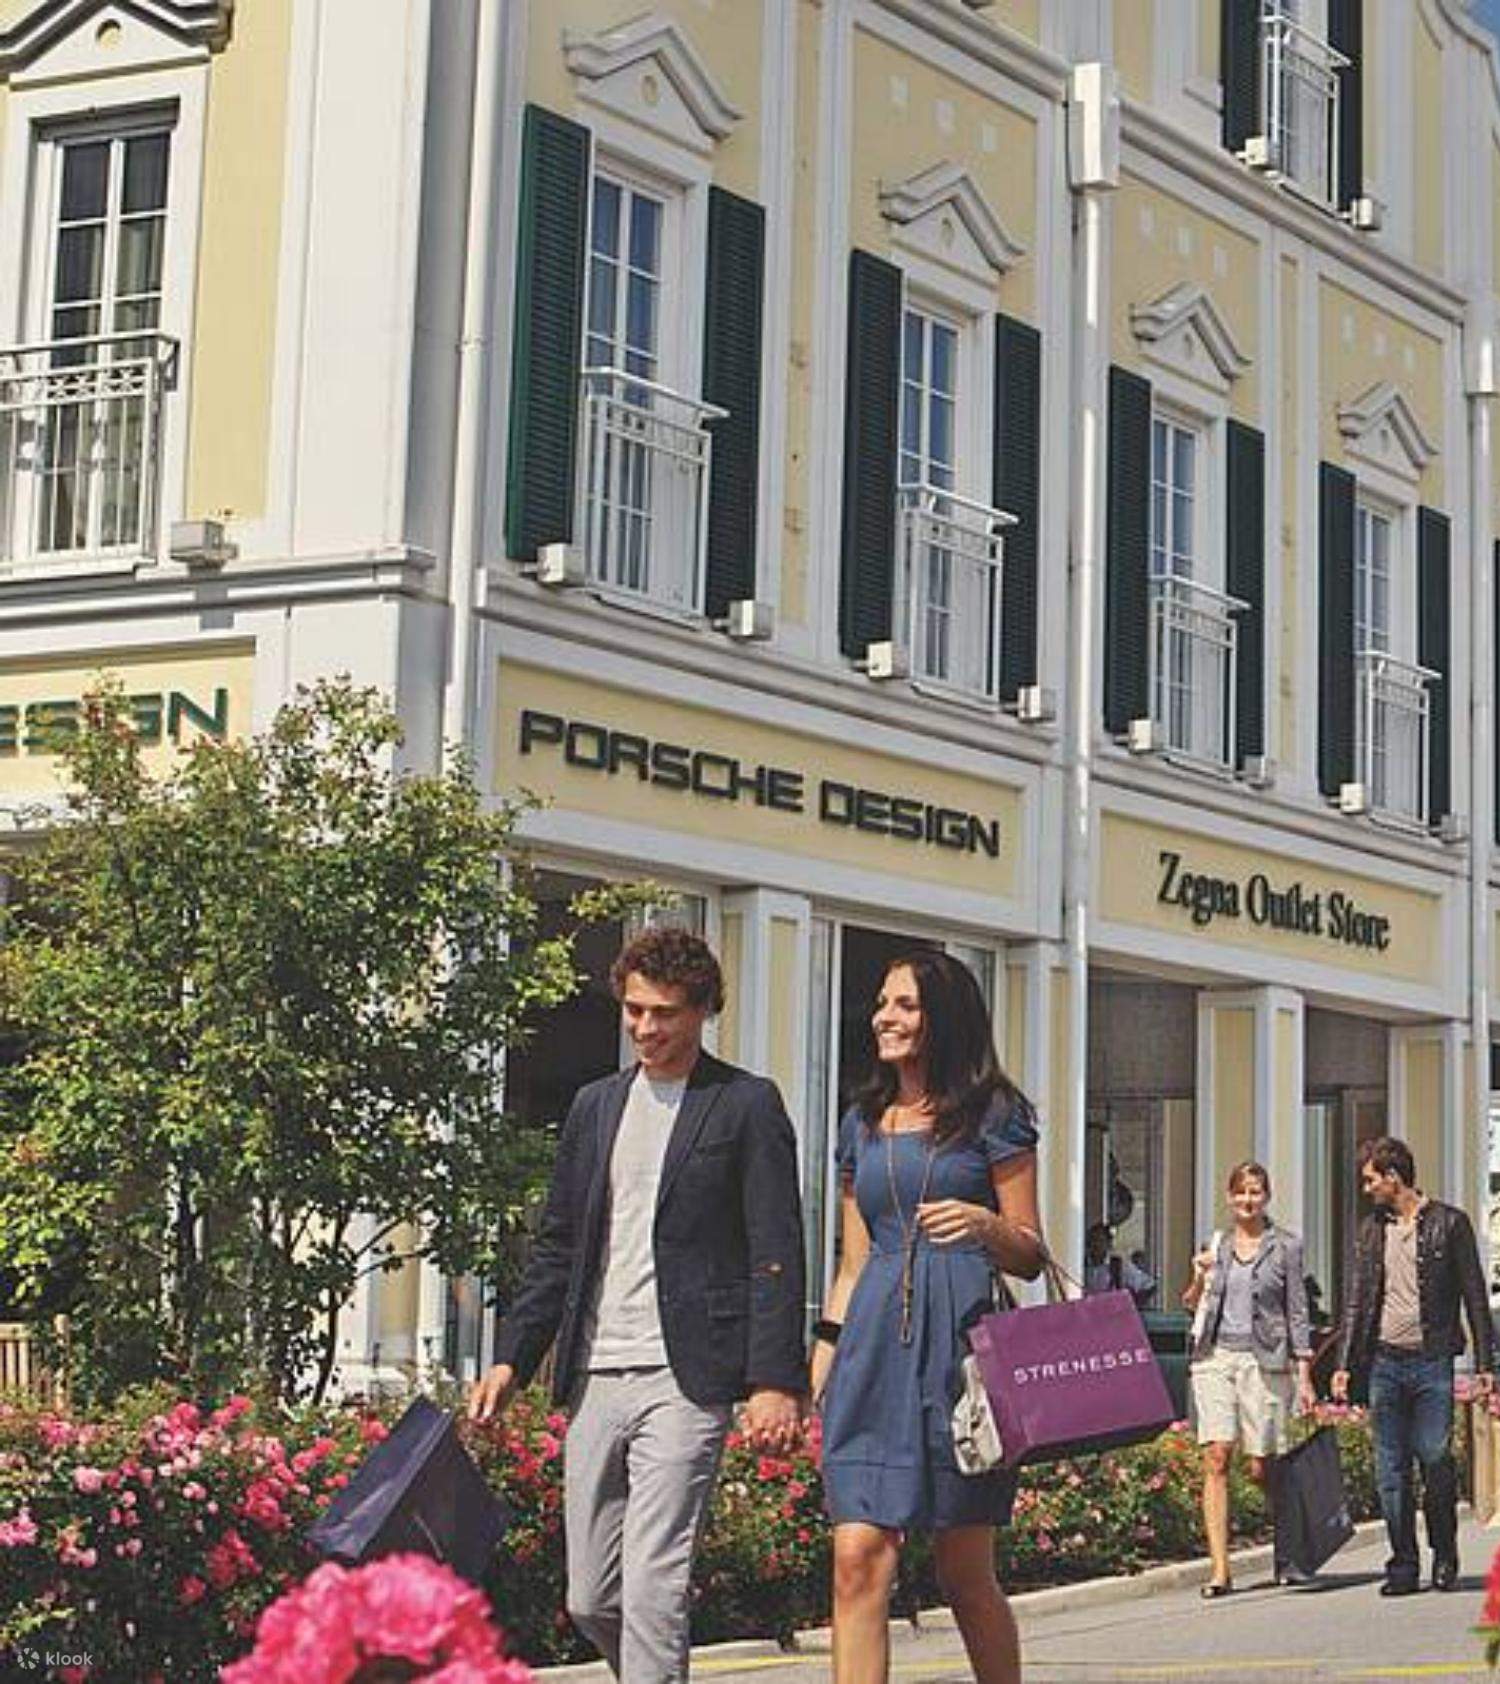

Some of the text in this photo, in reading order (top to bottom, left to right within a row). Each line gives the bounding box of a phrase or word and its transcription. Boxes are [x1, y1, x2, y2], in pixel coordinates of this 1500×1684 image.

[0, 688, 228, 756] SGN
[518, 709, 999, 857] PORSCHE DESIGN
[1157, 852, 1391, 951] Zegna Outlet Store
[1013, 1347, 1150, 1384] STRENESSE
